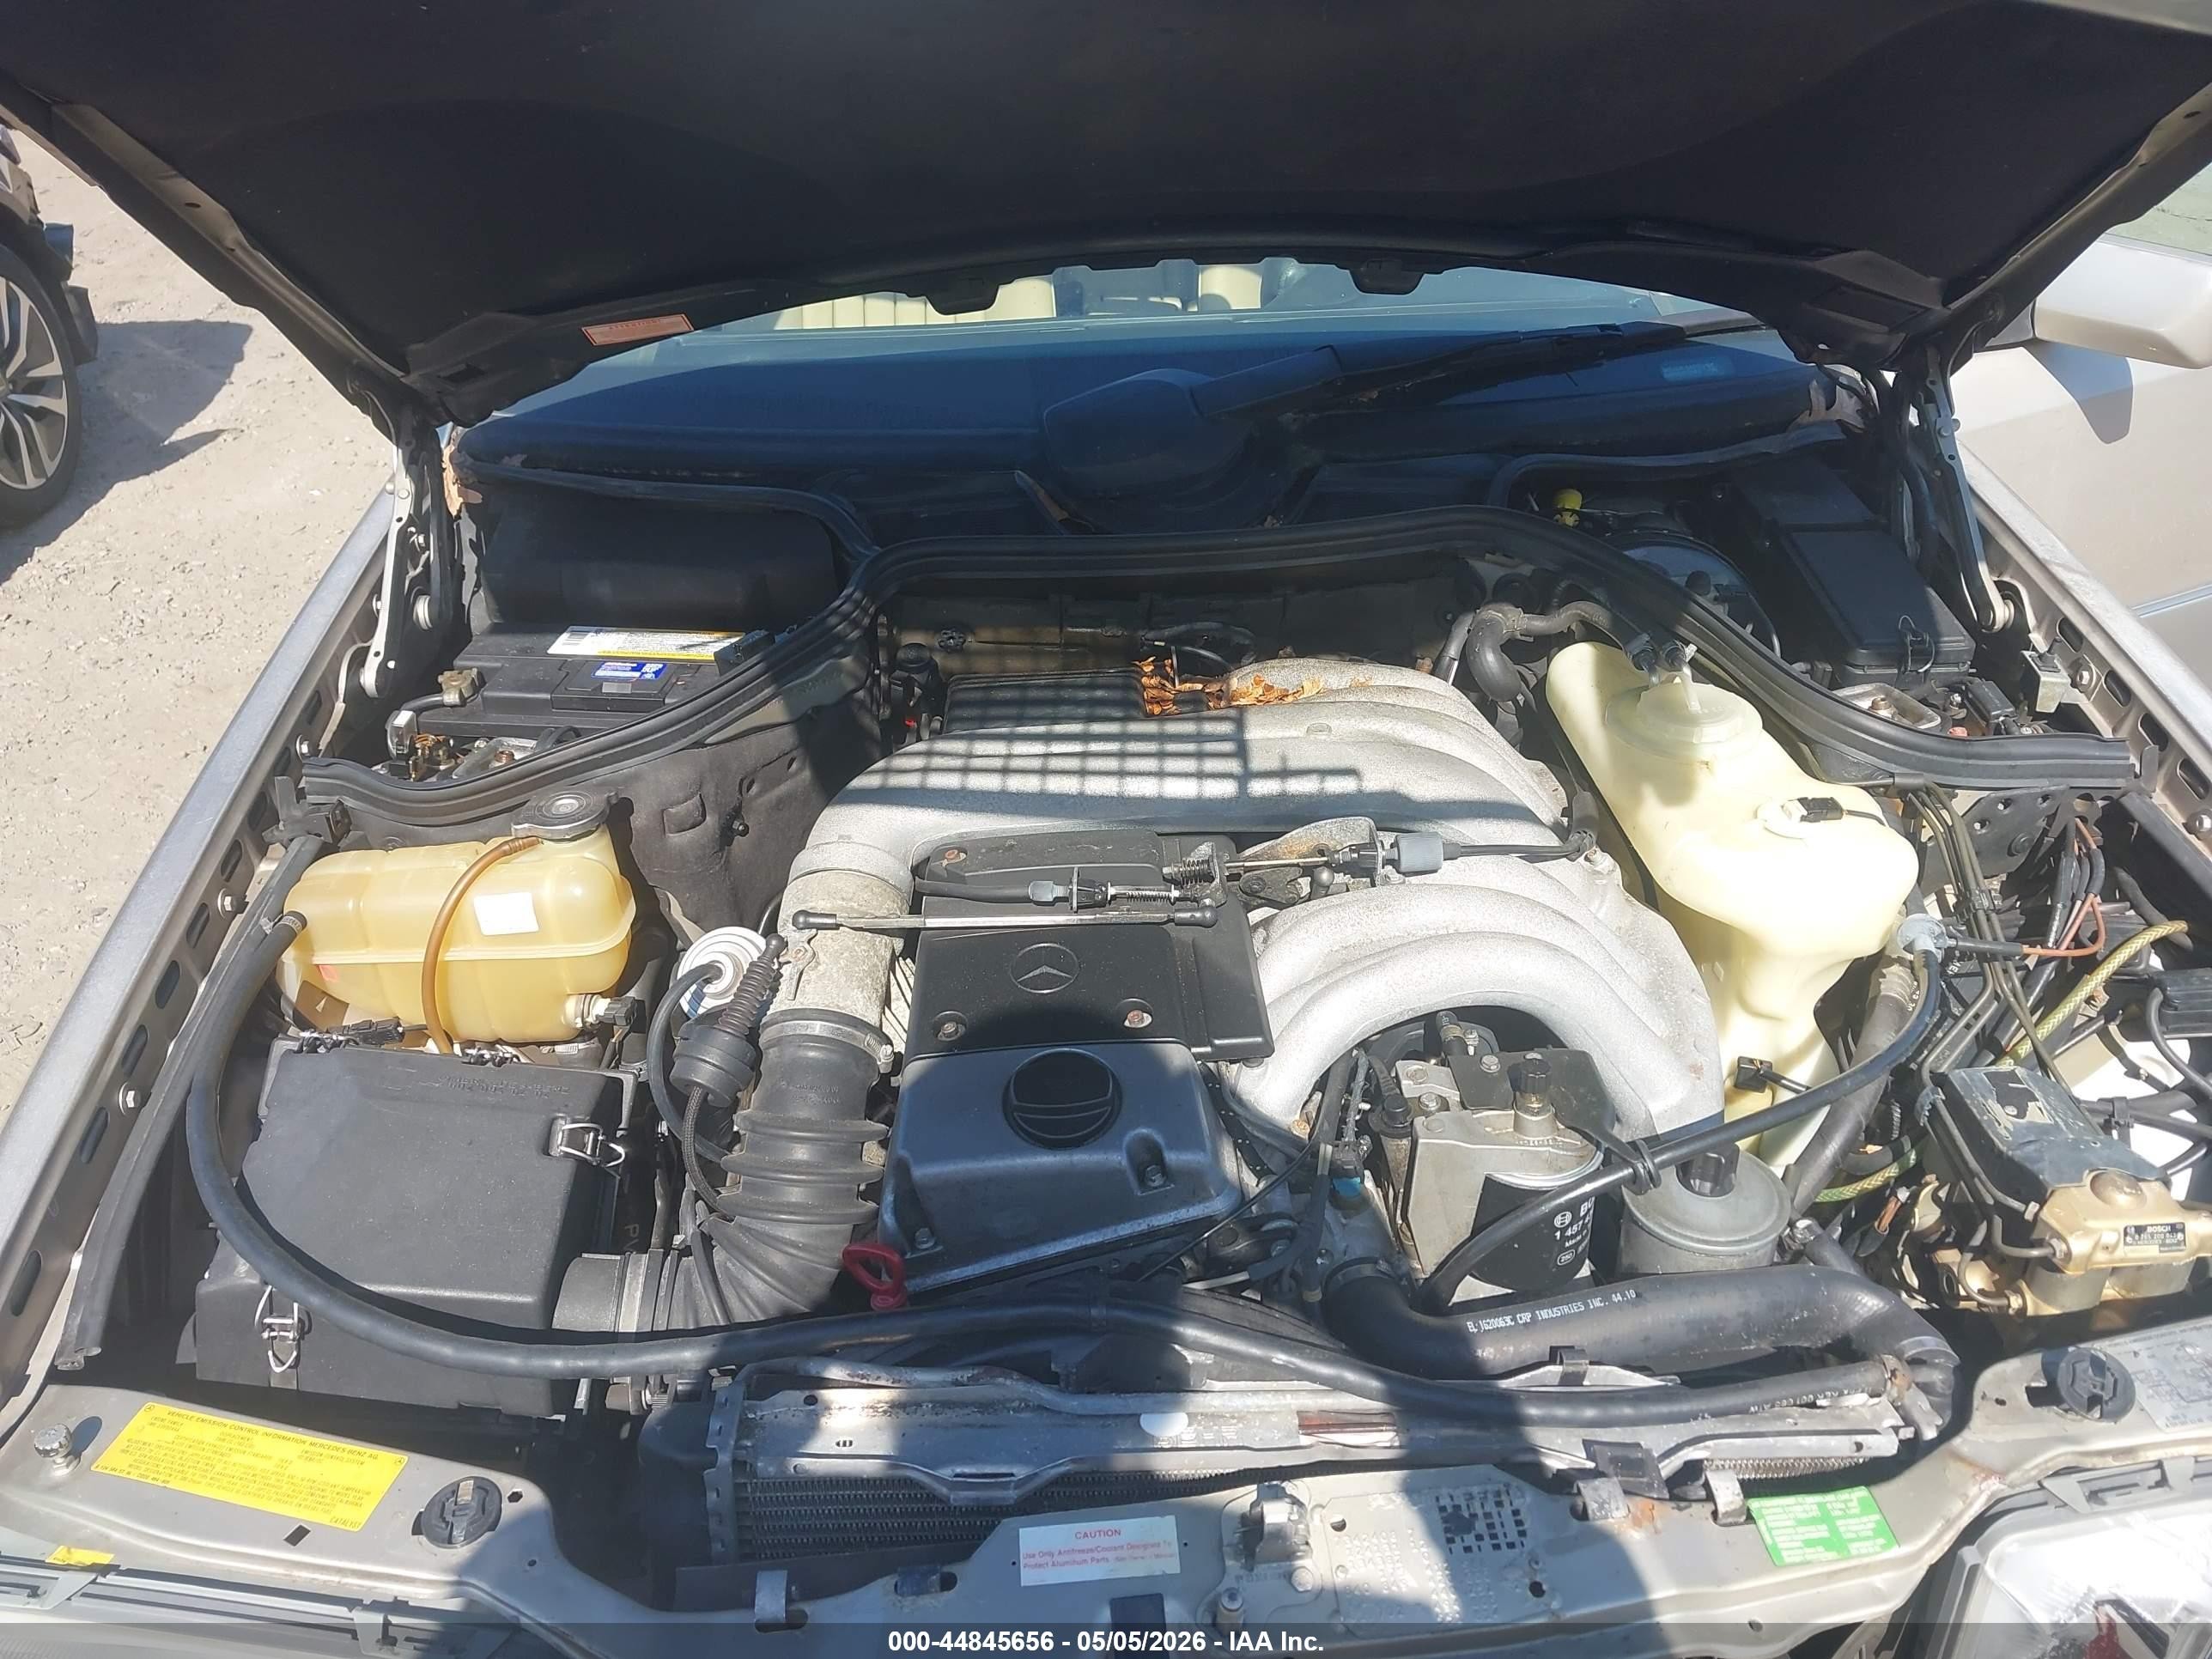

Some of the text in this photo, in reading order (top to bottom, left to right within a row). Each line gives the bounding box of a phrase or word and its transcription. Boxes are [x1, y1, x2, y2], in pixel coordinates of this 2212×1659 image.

[1565, 1220, 1583, 1237] 457
[1516, 1312, 1532, 1324] CRP
[1535, 1301, 1585, 1318] INDUSTRIES
[1587, 1297, 1608, 1309] INC.
[1612, 1289, 1637, 1304] 44.10
[167, 1410, 194, 1422] VEHICLE
[196, 1416, 228, 1428] EMISSION
[229, 1424, 260, 1436] CONTROL
[262, 1431, 307, 1445] INFORMATION
[330, 1517, 362, 1531] CATALYST
[1075, 1528, 1121, 1540] CAUTION
[1023, 1552, 1036, 1560] Use
[1038, 1550, 1054, 1559] Only
[1023, 1561, 1048, 1571] Protect
[1051, 1558, 1088, 1568] Aluminum
[1091, 1555, 1109, 1565] Parts
